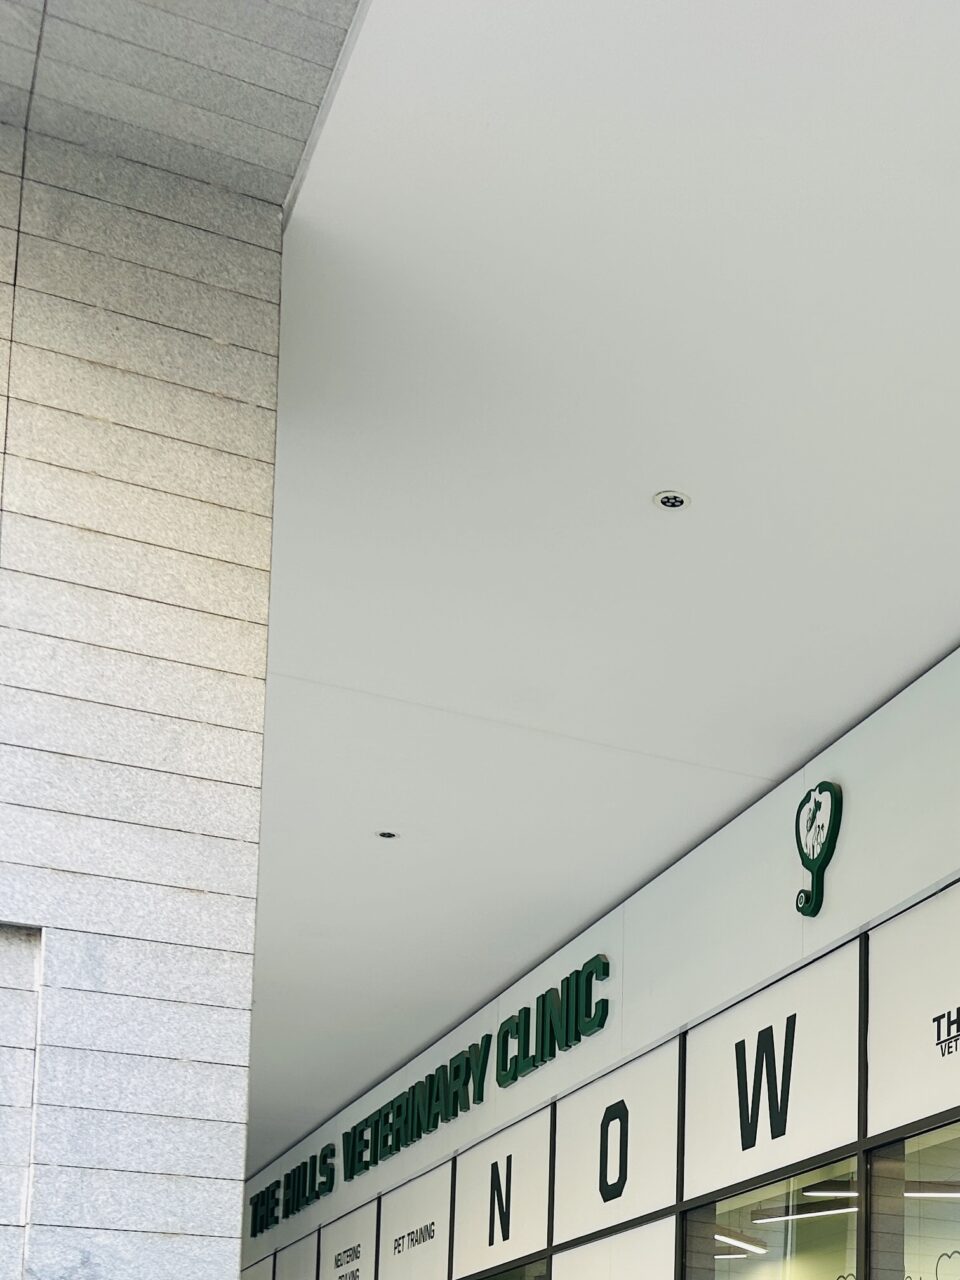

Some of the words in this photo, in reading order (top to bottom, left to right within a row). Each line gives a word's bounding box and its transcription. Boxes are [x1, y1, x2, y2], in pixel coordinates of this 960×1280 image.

[250, 1180, 281, 1238] THE
[282, 1143, 336, 1219] HILLS
[341, 1033, 493, 1182] VETERINARY
[496, 953, 610, 1088] CLINIC
[393, 1234, 406, 1256] PET
[406, 1221, 436, 1250] TRAINING
